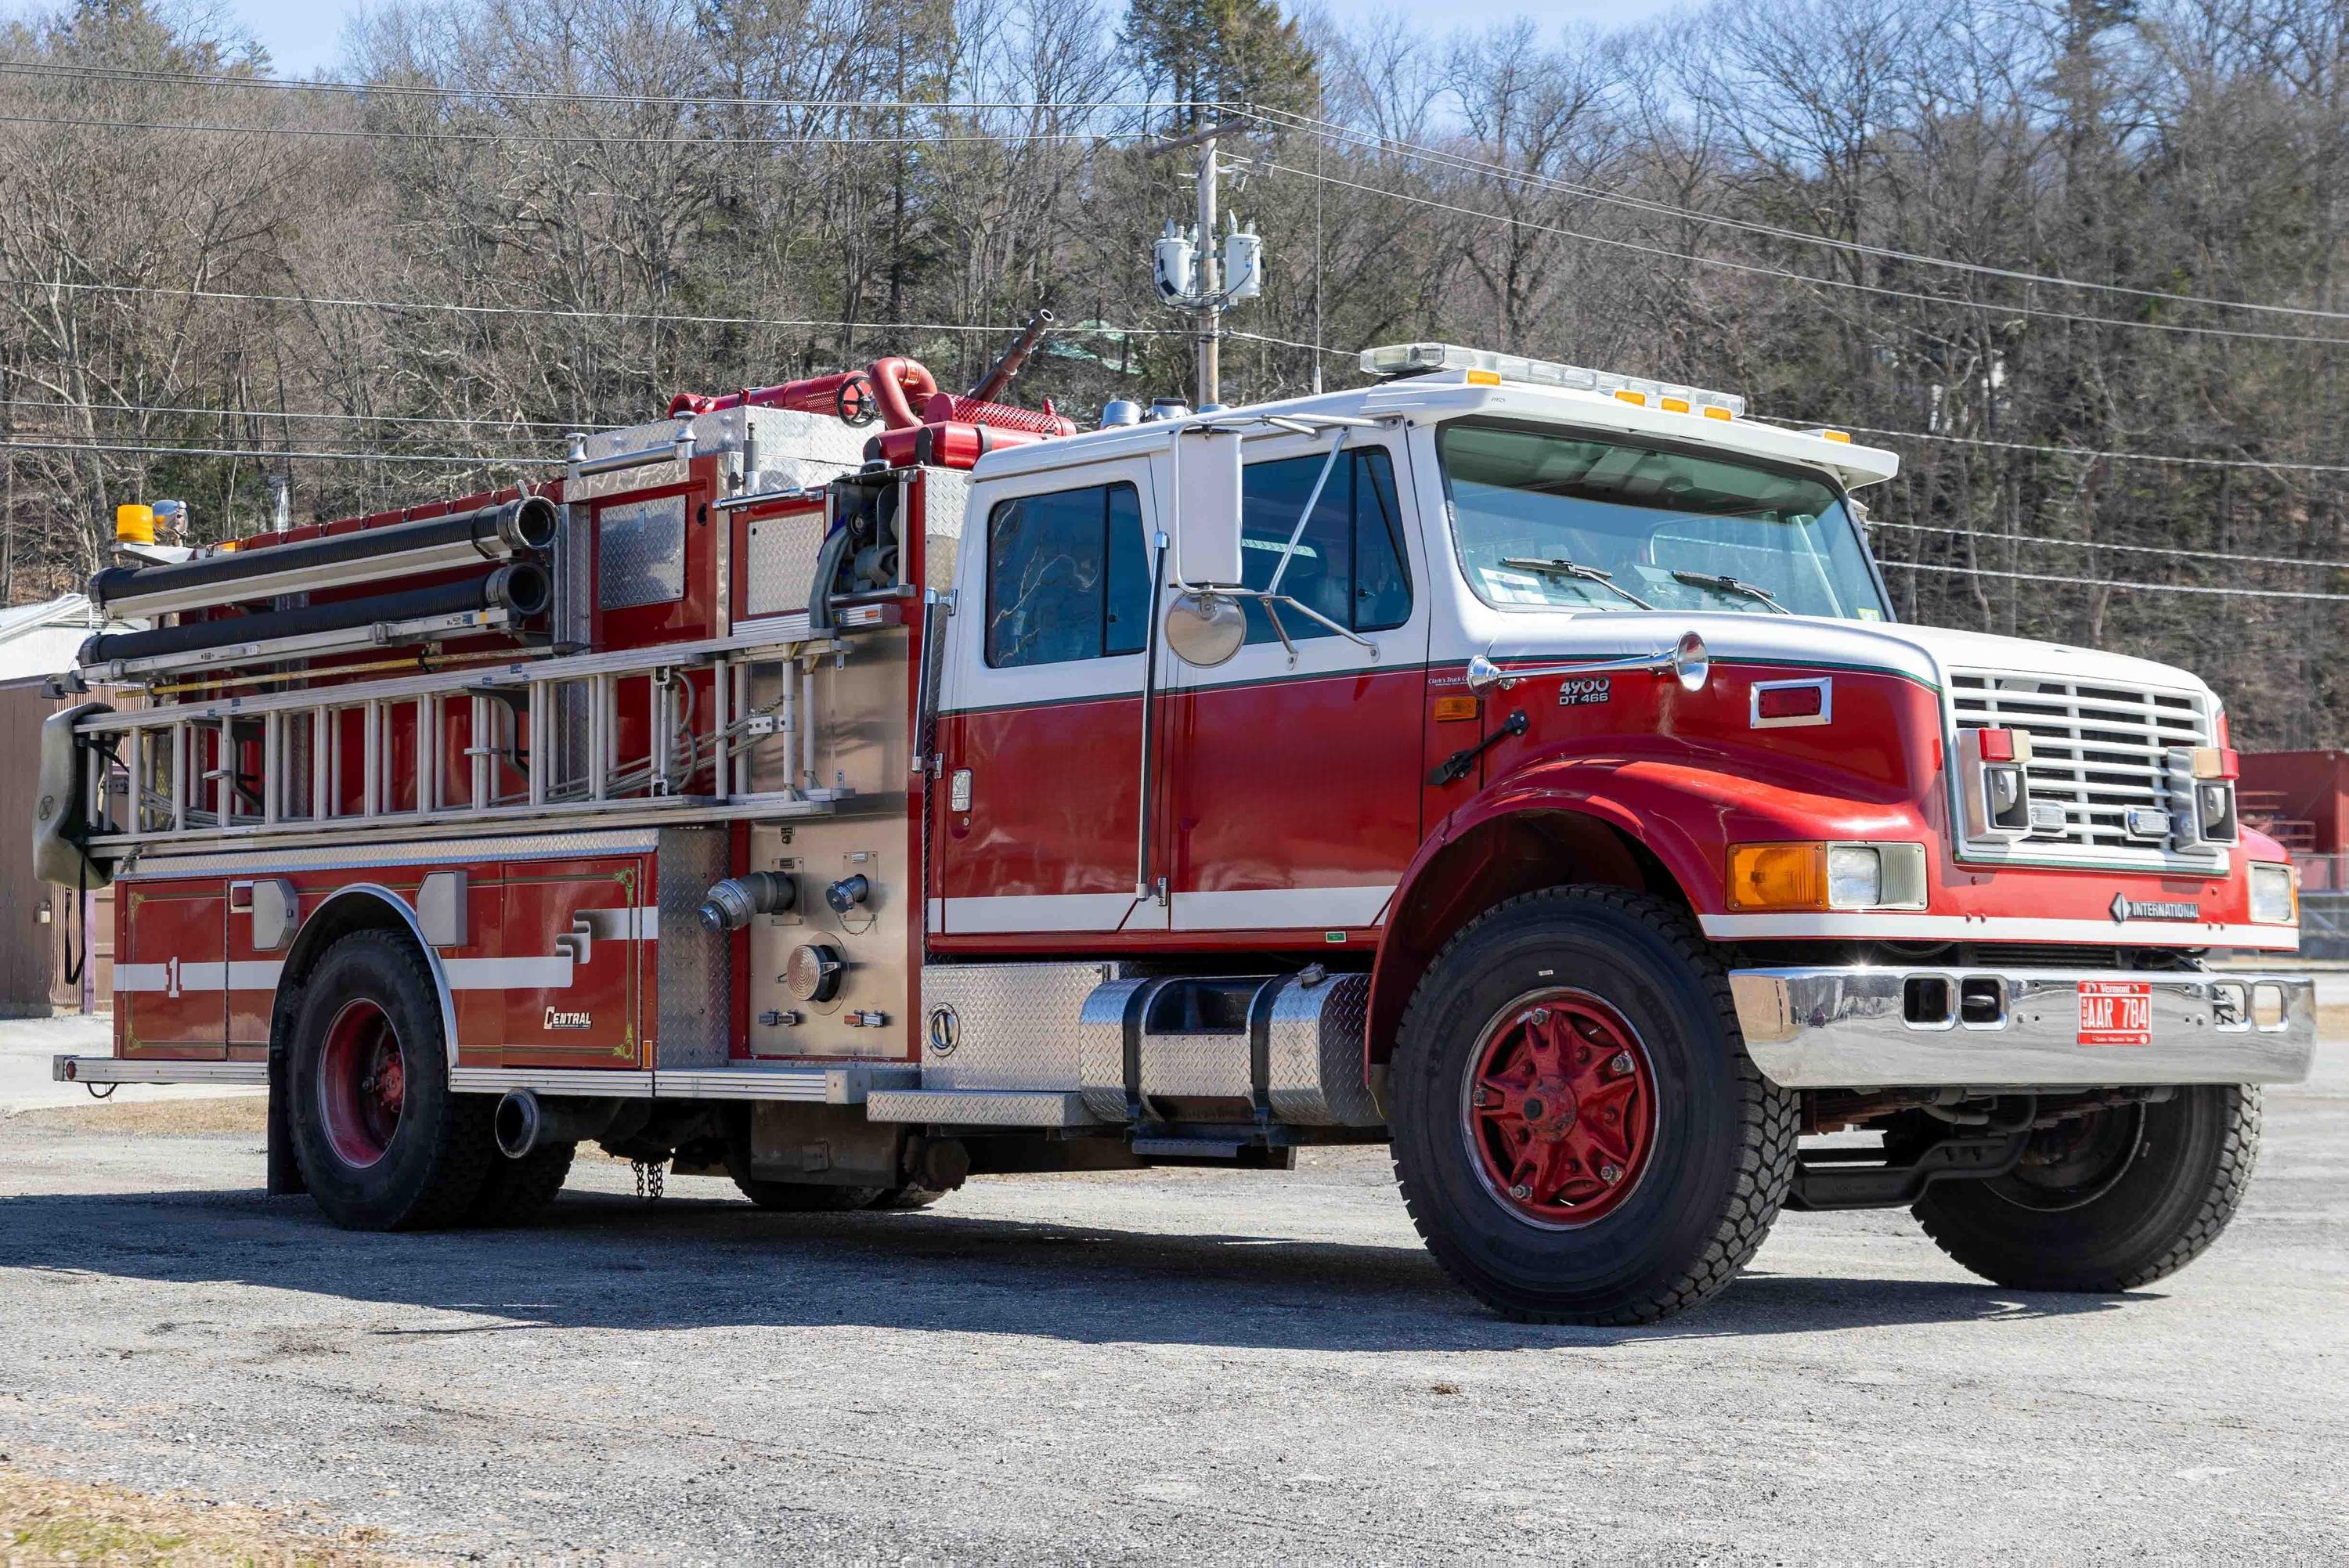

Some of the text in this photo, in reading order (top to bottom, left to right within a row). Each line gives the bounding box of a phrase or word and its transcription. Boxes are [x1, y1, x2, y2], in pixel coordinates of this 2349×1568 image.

[1559, 677, 1610, 694] 4900
[1559, 693, 1608, 705] DT 466
[2132, 903, 2200, 918] INTERNATIONAL
[168, 957, 179, 998] 1
[2100, 983, 2131, 993] Vermont
[543, 1006, 592, 1029] CENTRAL
[2087, 998, 2147, 1029] AAR 784
